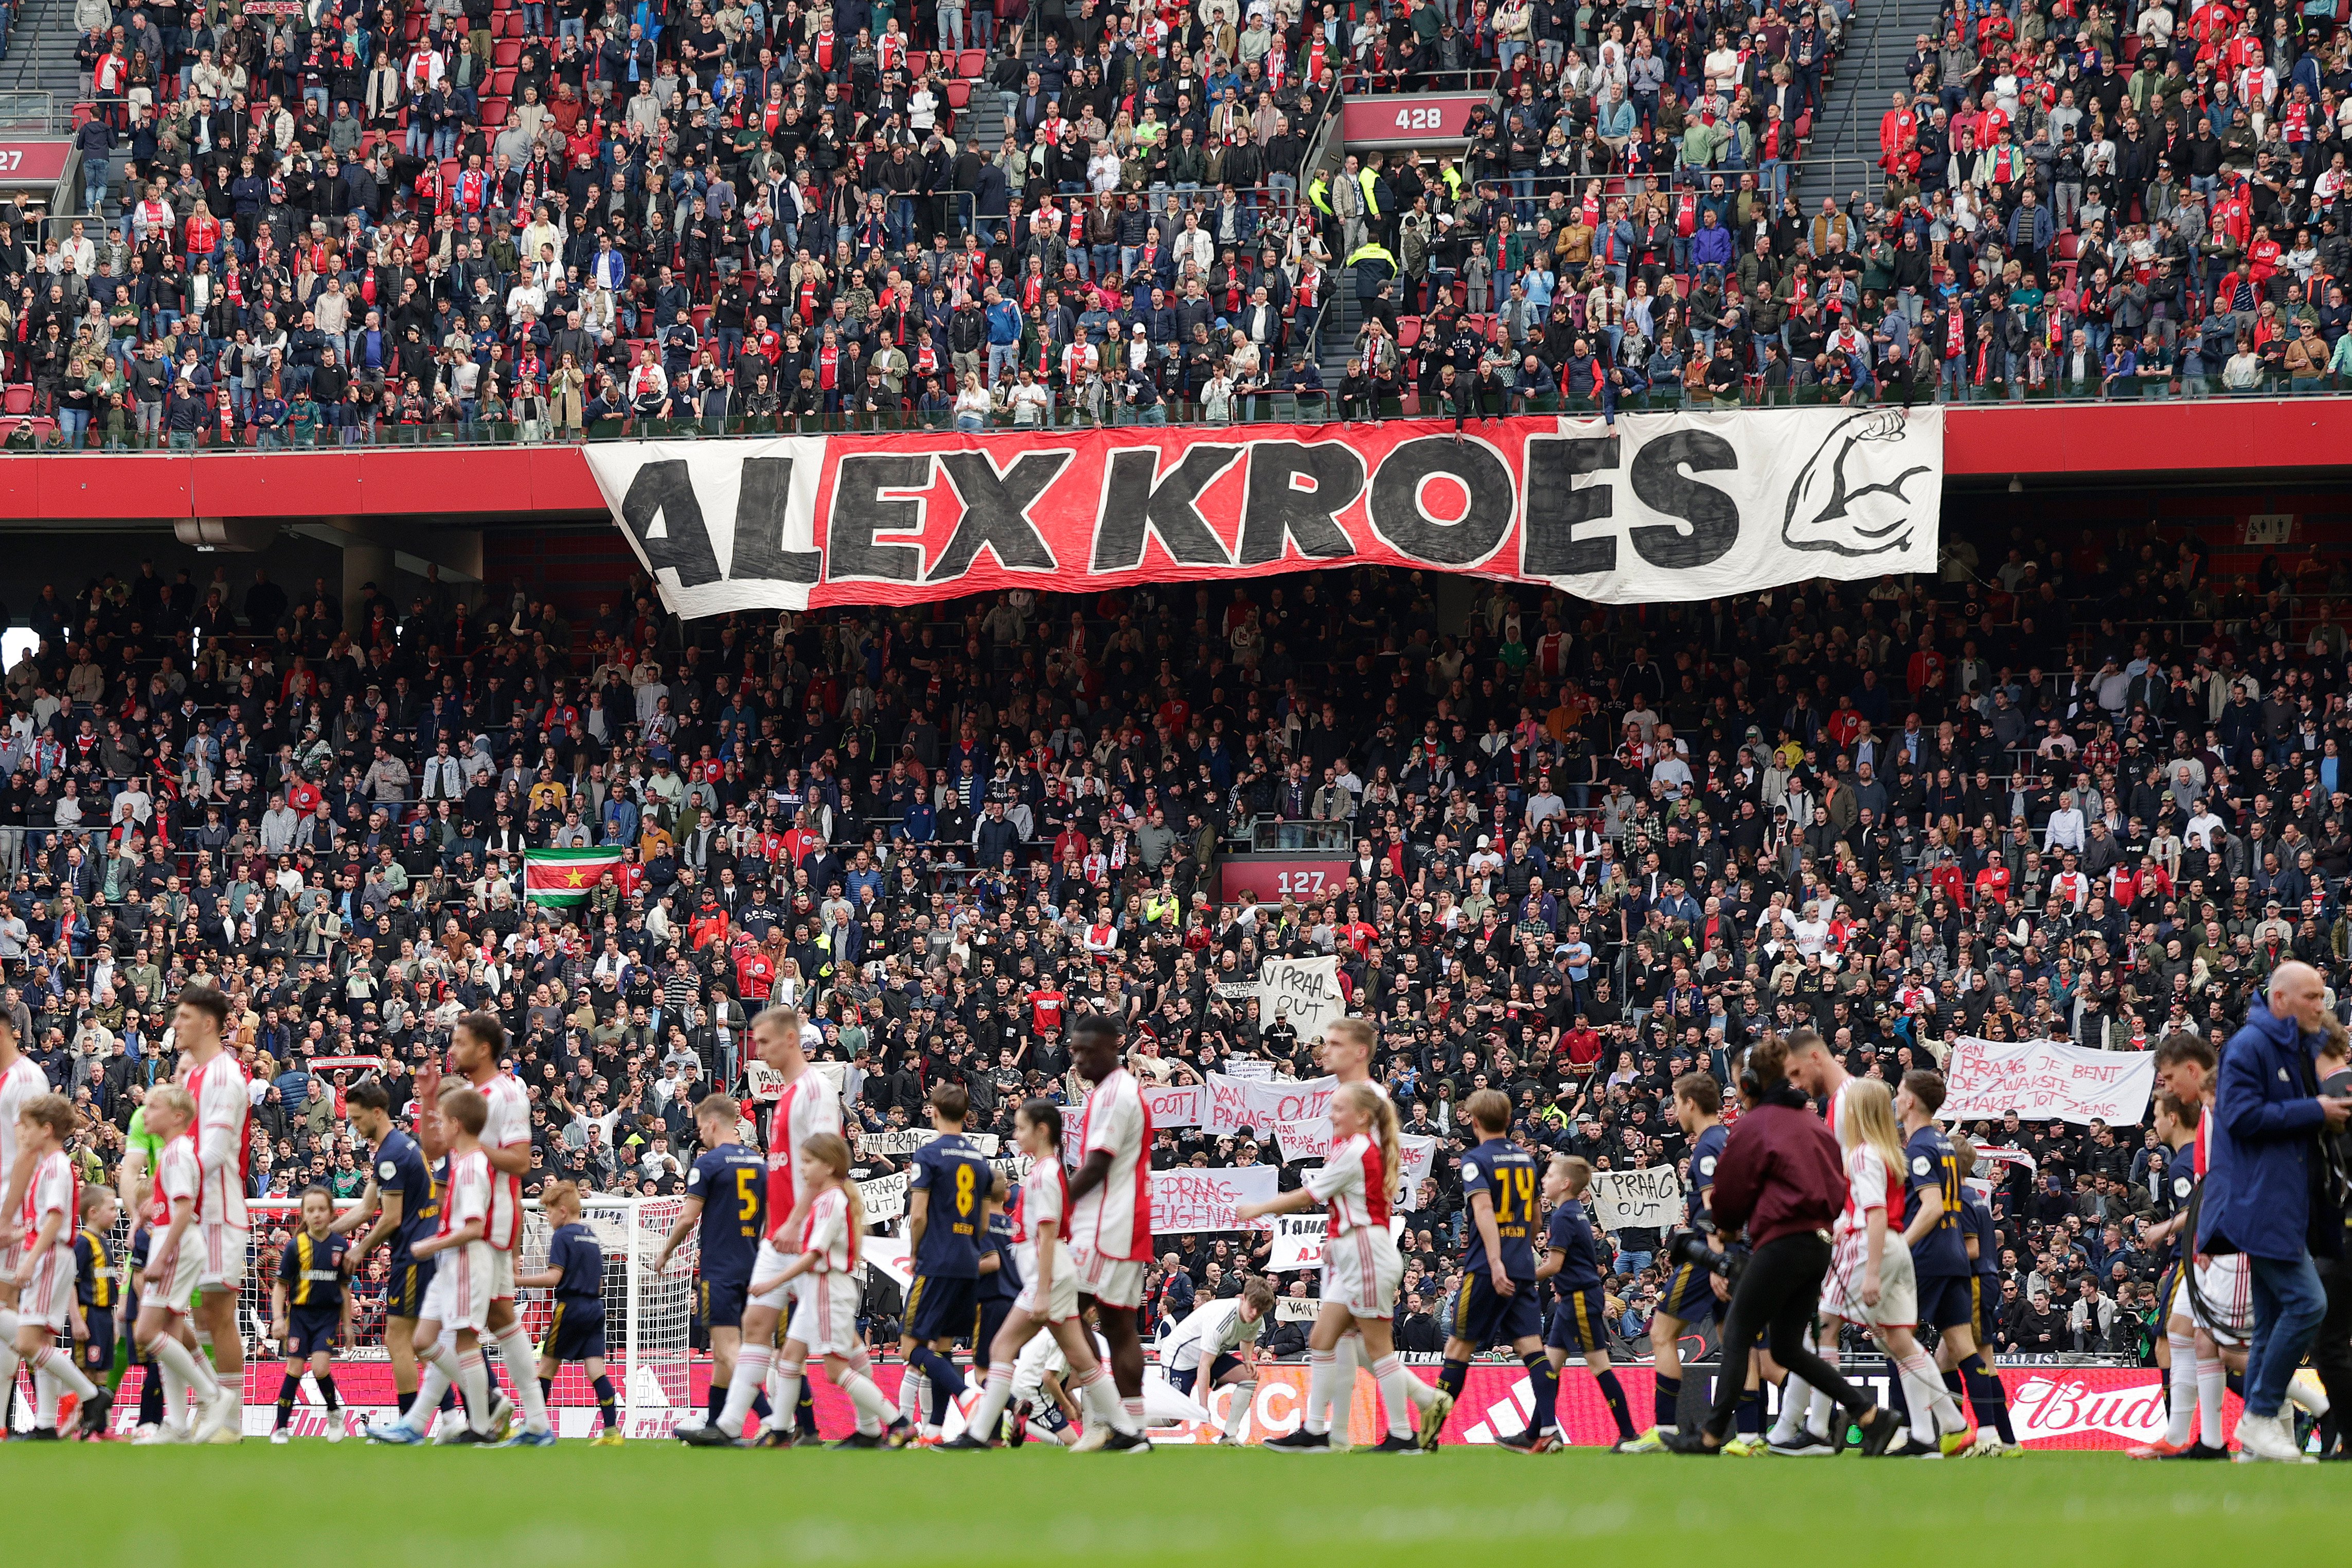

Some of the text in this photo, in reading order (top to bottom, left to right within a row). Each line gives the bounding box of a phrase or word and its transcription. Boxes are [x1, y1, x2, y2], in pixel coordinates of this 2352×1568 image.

[1396, 109, 1441, 129] 428
[622, 430, 1739, 588] ALEX KROES
[1278, 871, 1325, 893] 127
[1277, 995, 1324, 1023] OUT
[1955, 1043, 1985, 1058] VAN
[1960, 1055, 2123, 1083] PRAAG JE BENT
[1210, 1082, 1245, 1108] VAN
[1951, 1074, 2072, 1093] DE ZWAKSTE
[1152, 1092, 1197, 1122] OUT!
[2027, 1091, 2066, 1108] TOT
[1213, 1106, 1276, 1132] PRAAG
[1274, 1125, 1295, 1134] VAN
[1306, 1139, 1330, 1156] OUT!
[736, 1168, 759, 1221] 5
[955, 1163, 976, 1218] 8
[1161, 1177, 1243, 1204] PRAAG
[1494, 1167, 1535, 1224] 14
[1611, 1172, 1673, 1200] PRAAG
[865, 1193, 898, 1214] UT!
[1617, 1201, 1660, 1218] OUT
[1288, 1302, 1312, 1316] VAN
[2027, 1380, 2166, 1429] Bud
